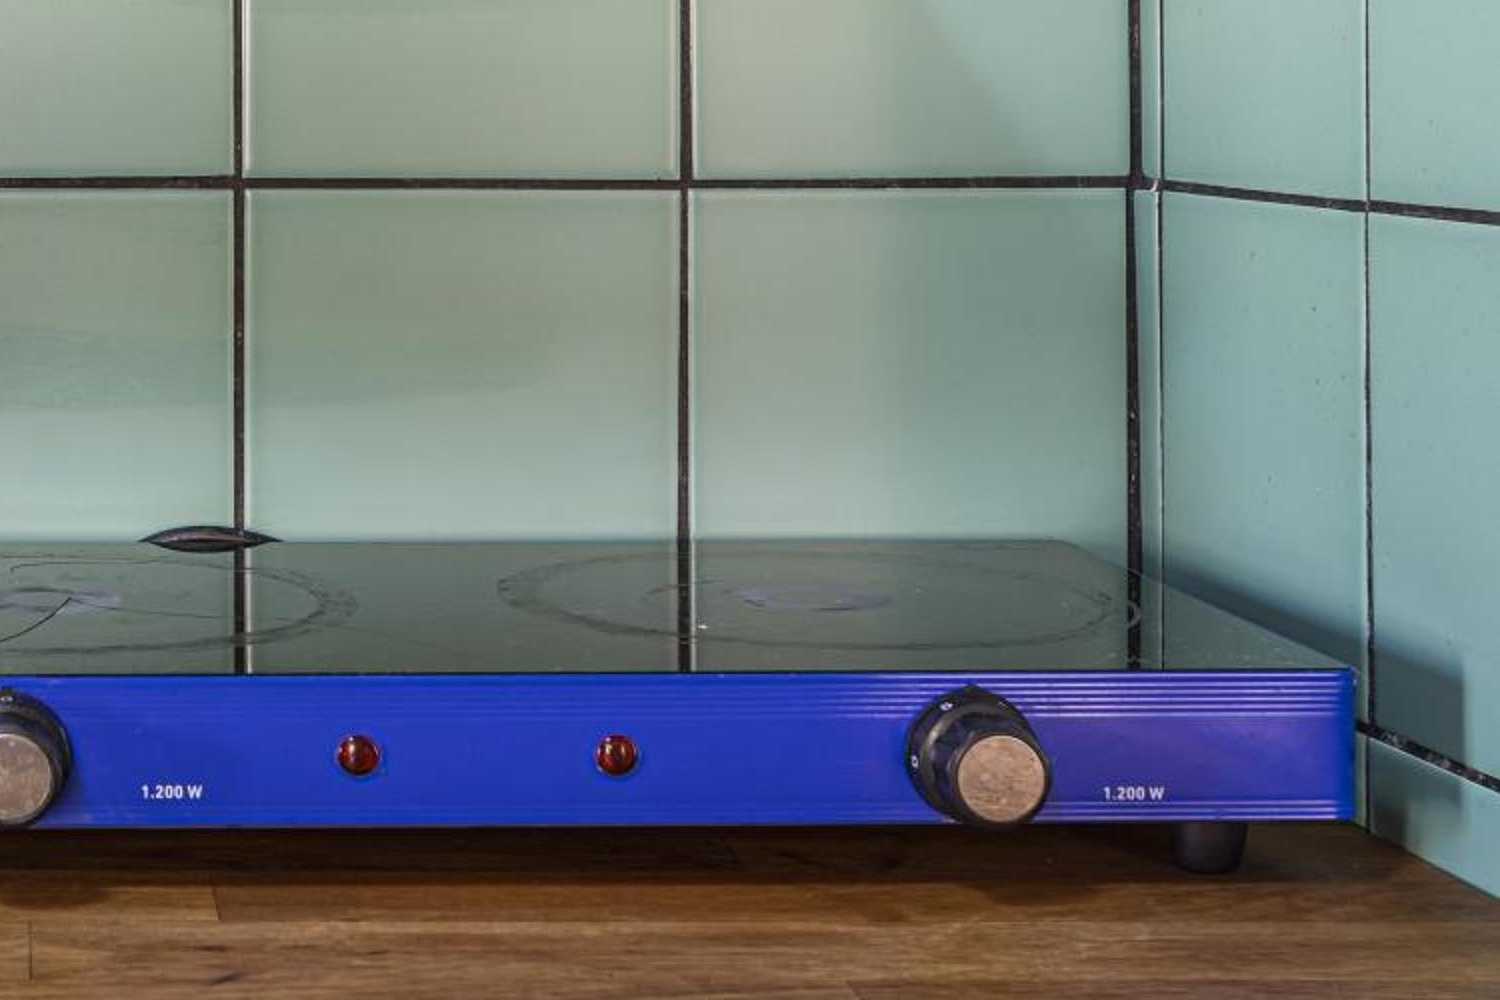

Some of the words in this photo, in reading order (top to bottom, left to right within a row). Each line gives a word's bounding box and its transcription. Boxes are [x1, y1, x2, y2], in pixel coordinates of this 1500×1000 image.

[141, 784, 183, 799] 1.200
[187, 784, 203, 799] W
[1103, 786, 1145, 801] 1.200
[1149, 786, 1165, 801] W
